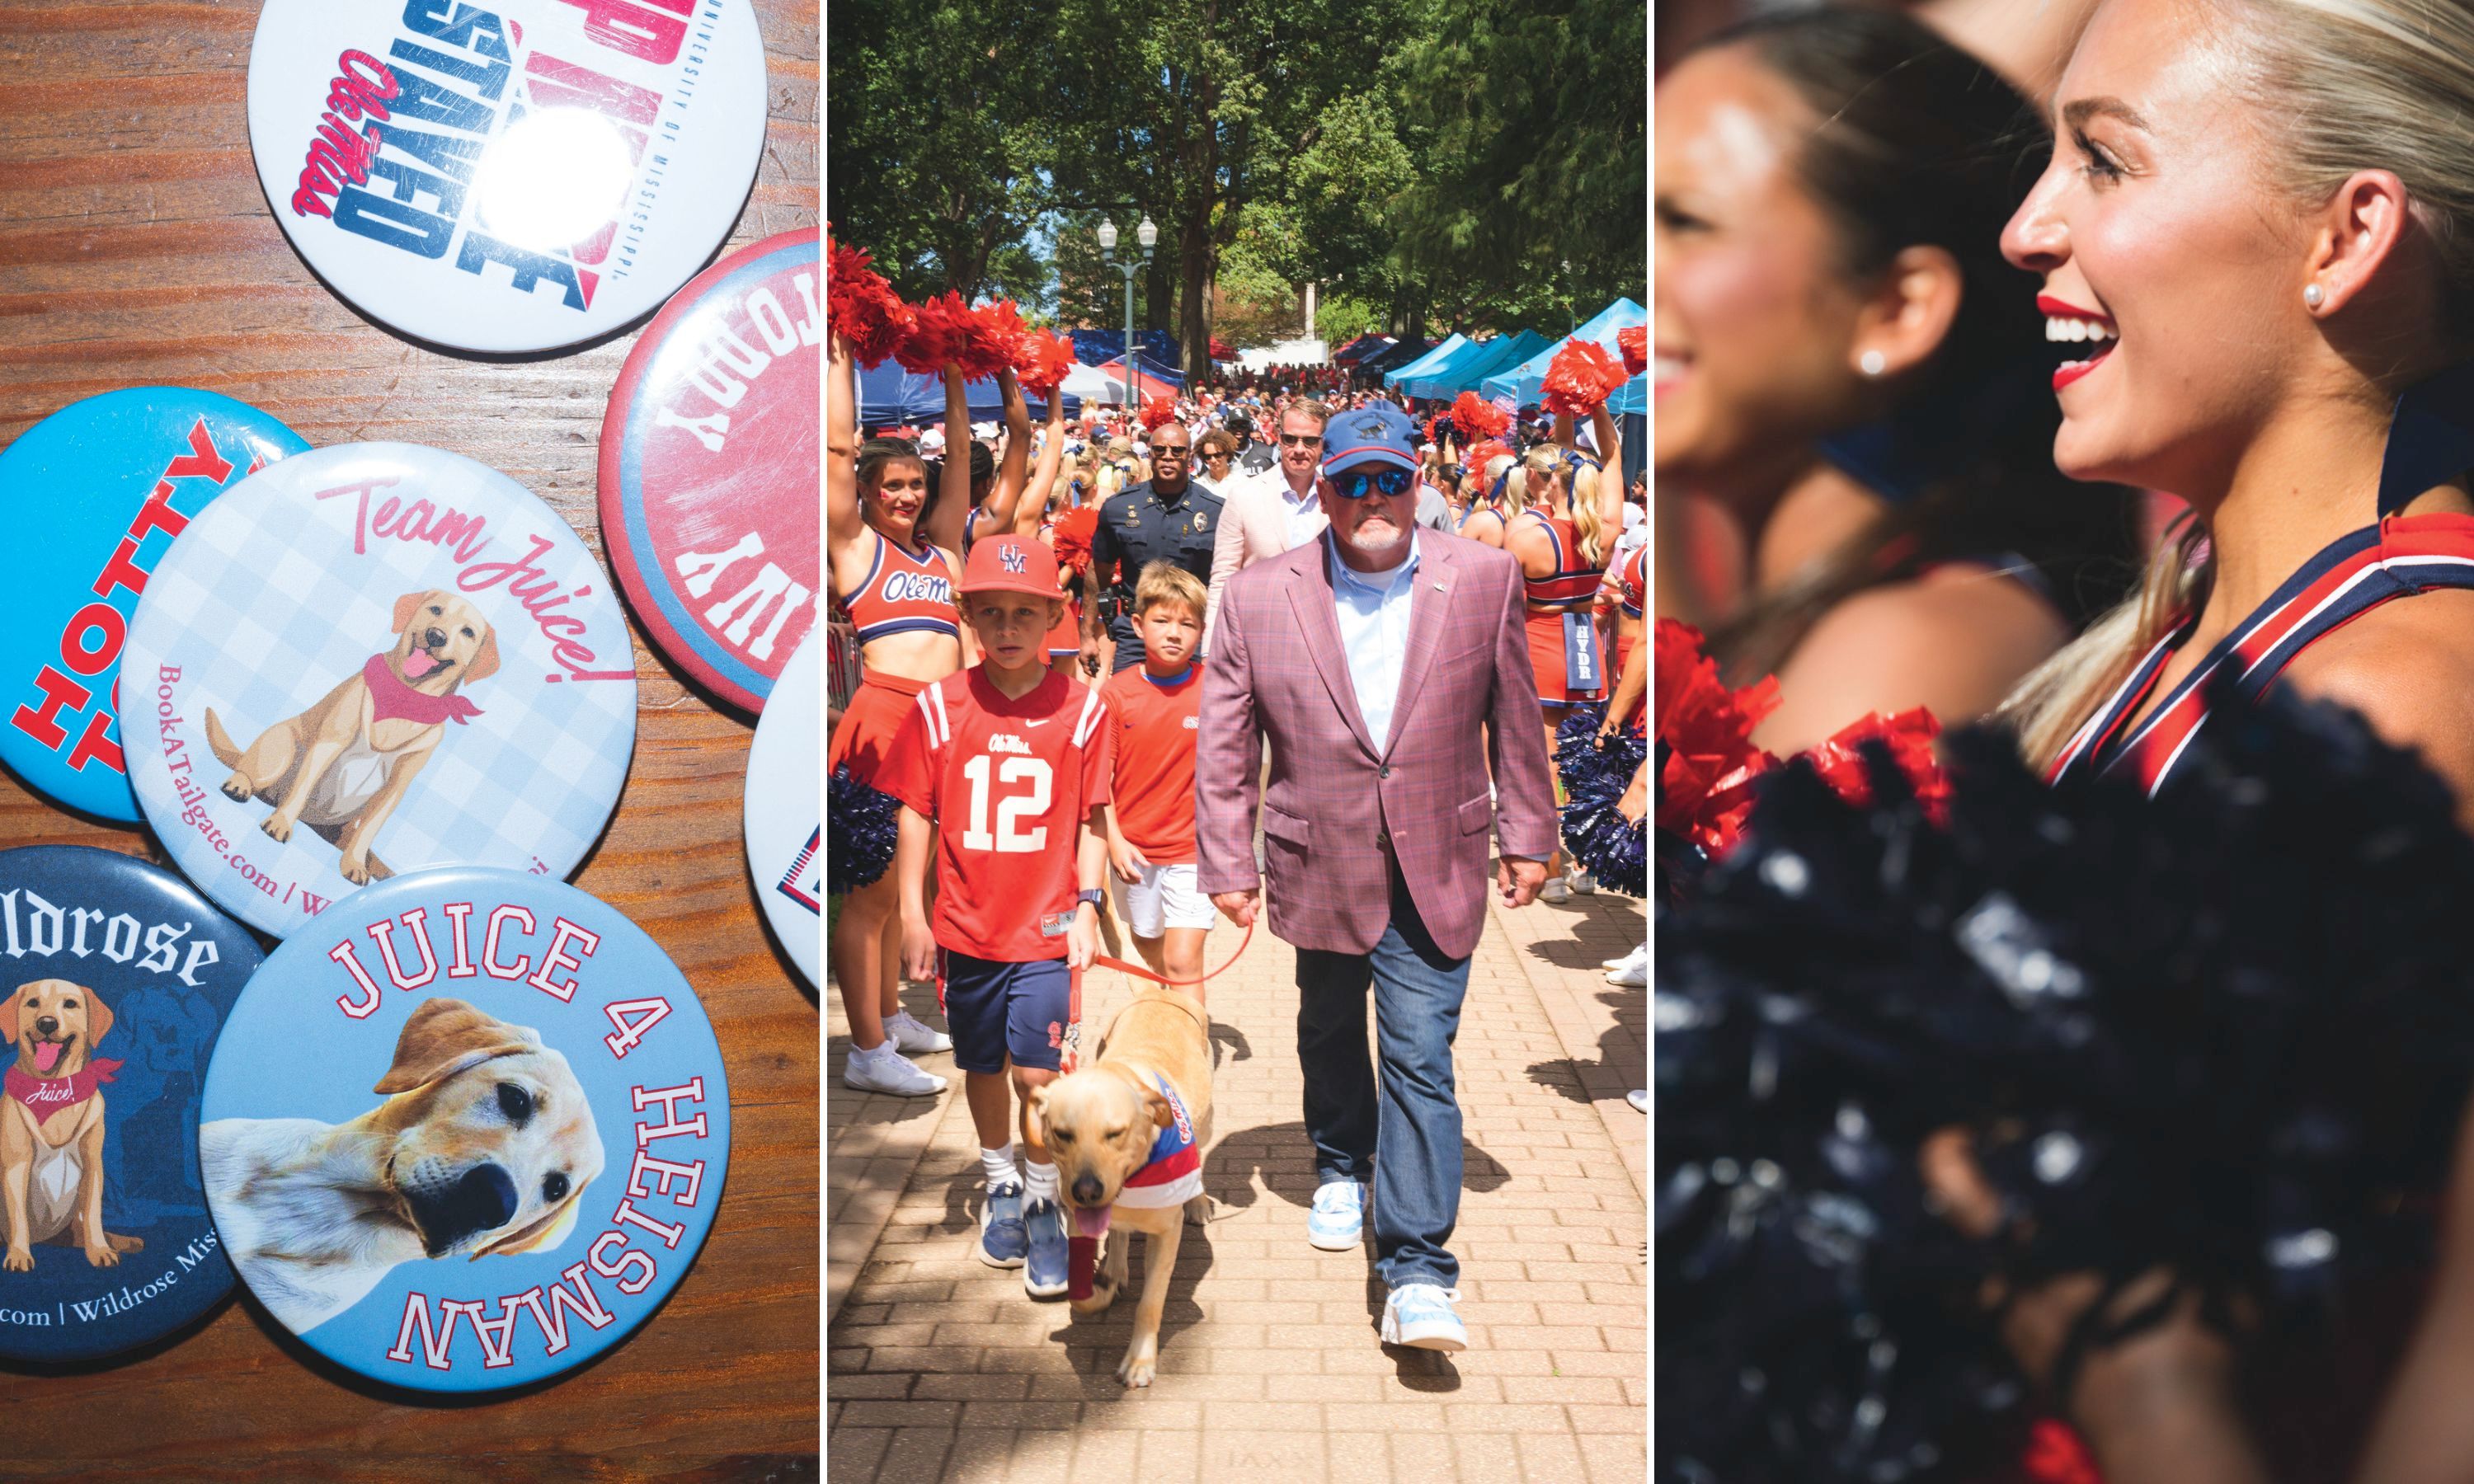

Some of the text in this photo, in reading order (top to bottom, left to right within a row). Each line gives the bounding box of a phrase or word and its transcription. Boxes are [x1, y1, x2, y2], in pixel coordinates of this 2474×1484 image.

[291, 49, 400, 219] Ole Miss
[613, 0, 723, 276] UNIVERSITY OF MISSISSIPPI
[10, 416, 235, 752] HOTTY
[314, 474, 636, 683] Team Juice!
[157, 659, 279, 899] BookATailgate.com
[962, 754, 1053, 852] 12
[328, 902, 709, 1371] JUICE 4 HEISMAN
[69, 1270, 178, 1322] Wildrose
